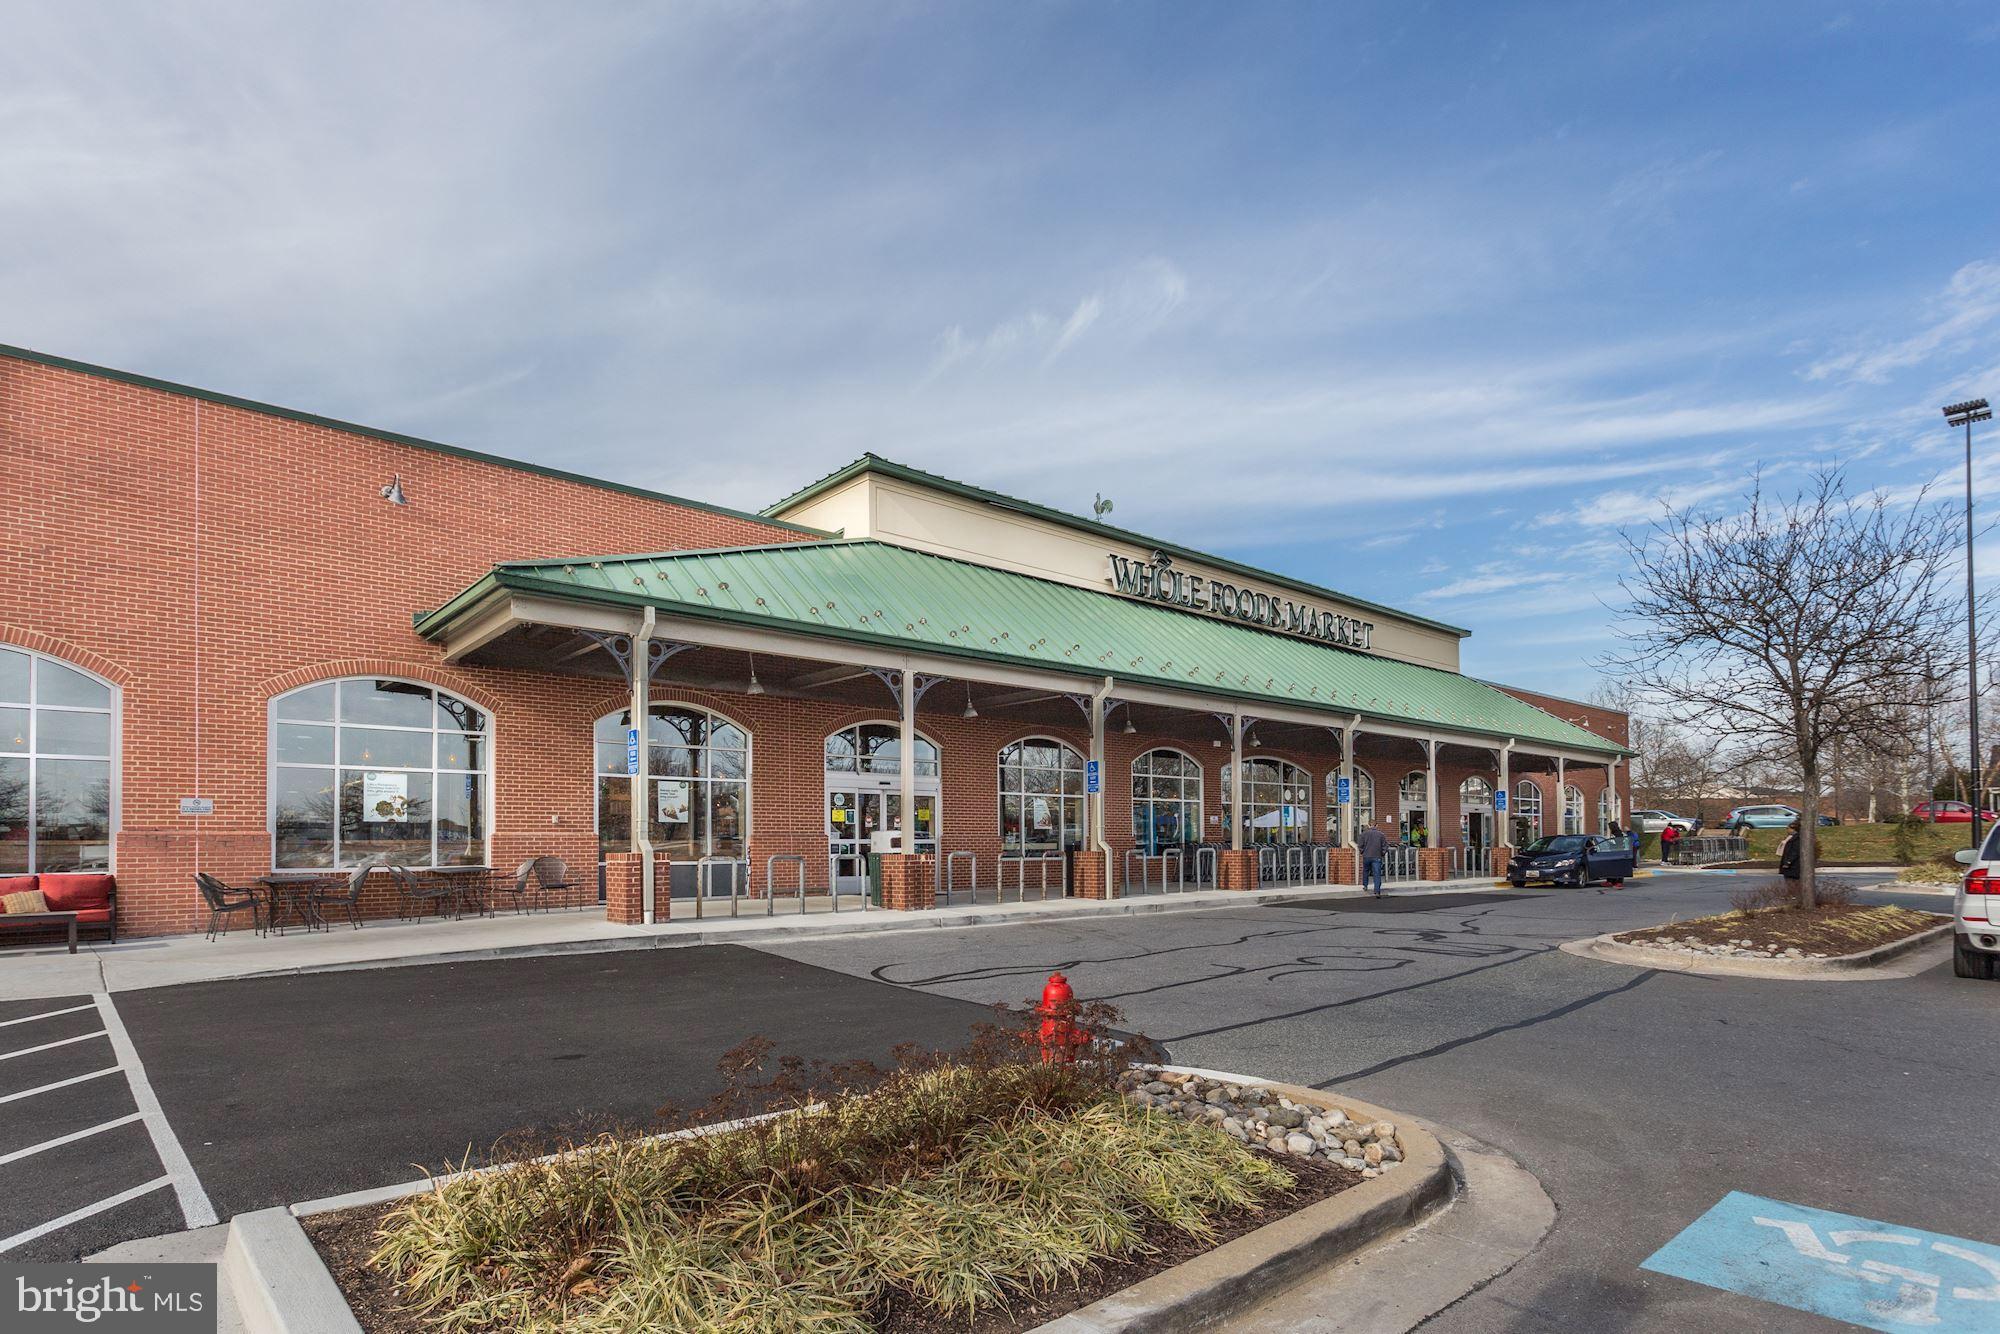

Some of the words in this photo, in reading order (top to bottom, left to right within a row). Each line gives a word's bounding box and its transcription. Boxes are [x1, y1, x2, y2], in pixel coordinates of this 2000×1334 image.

[1105, 552, 1204, 609] WHOLE
[1207, 580, 1283, 628] FOODS
[1285, 601, 1374, 650] MARKET
